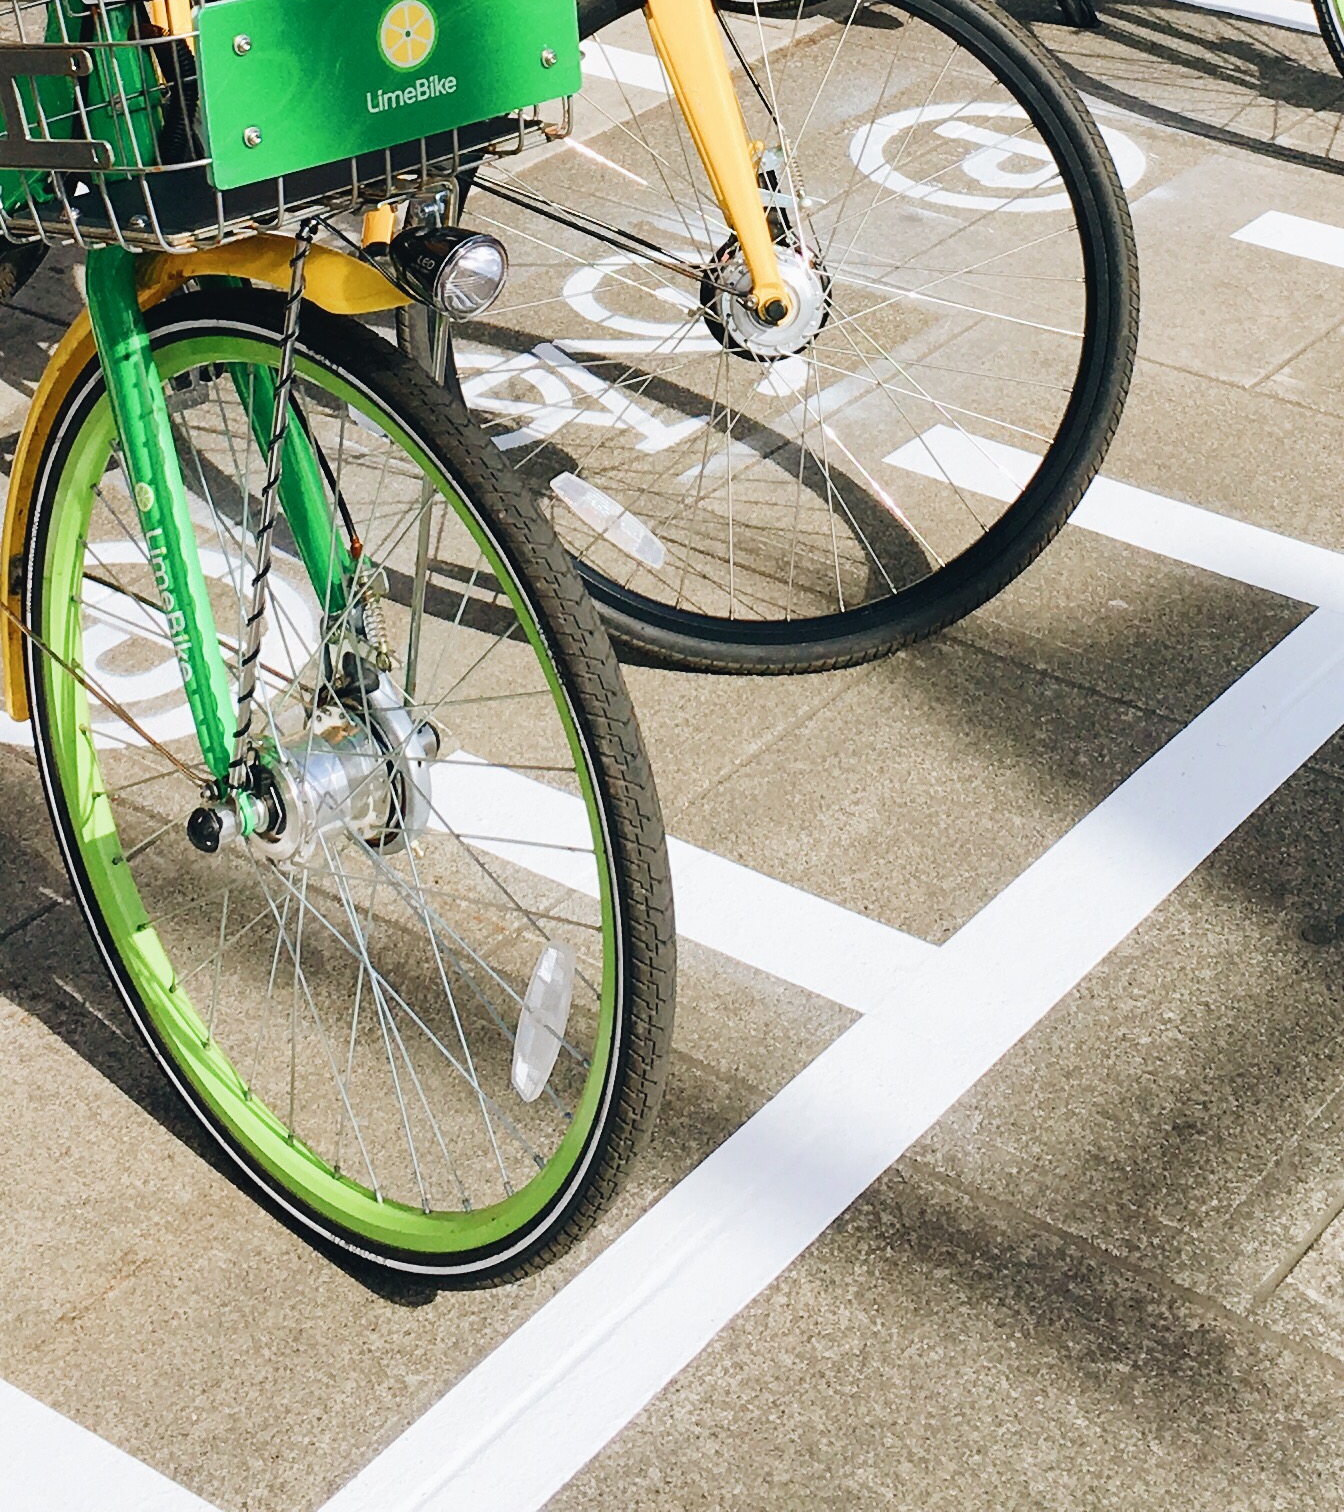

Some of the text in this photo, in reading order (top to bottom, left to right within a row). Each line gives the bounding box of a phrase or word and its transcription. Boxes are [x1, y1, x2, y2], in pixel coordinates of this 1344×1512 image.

[366, 74, 457, 113] LimeBike
[417, 254, 436, 270] LED
[145, 526, 194, 683] LimeBike
